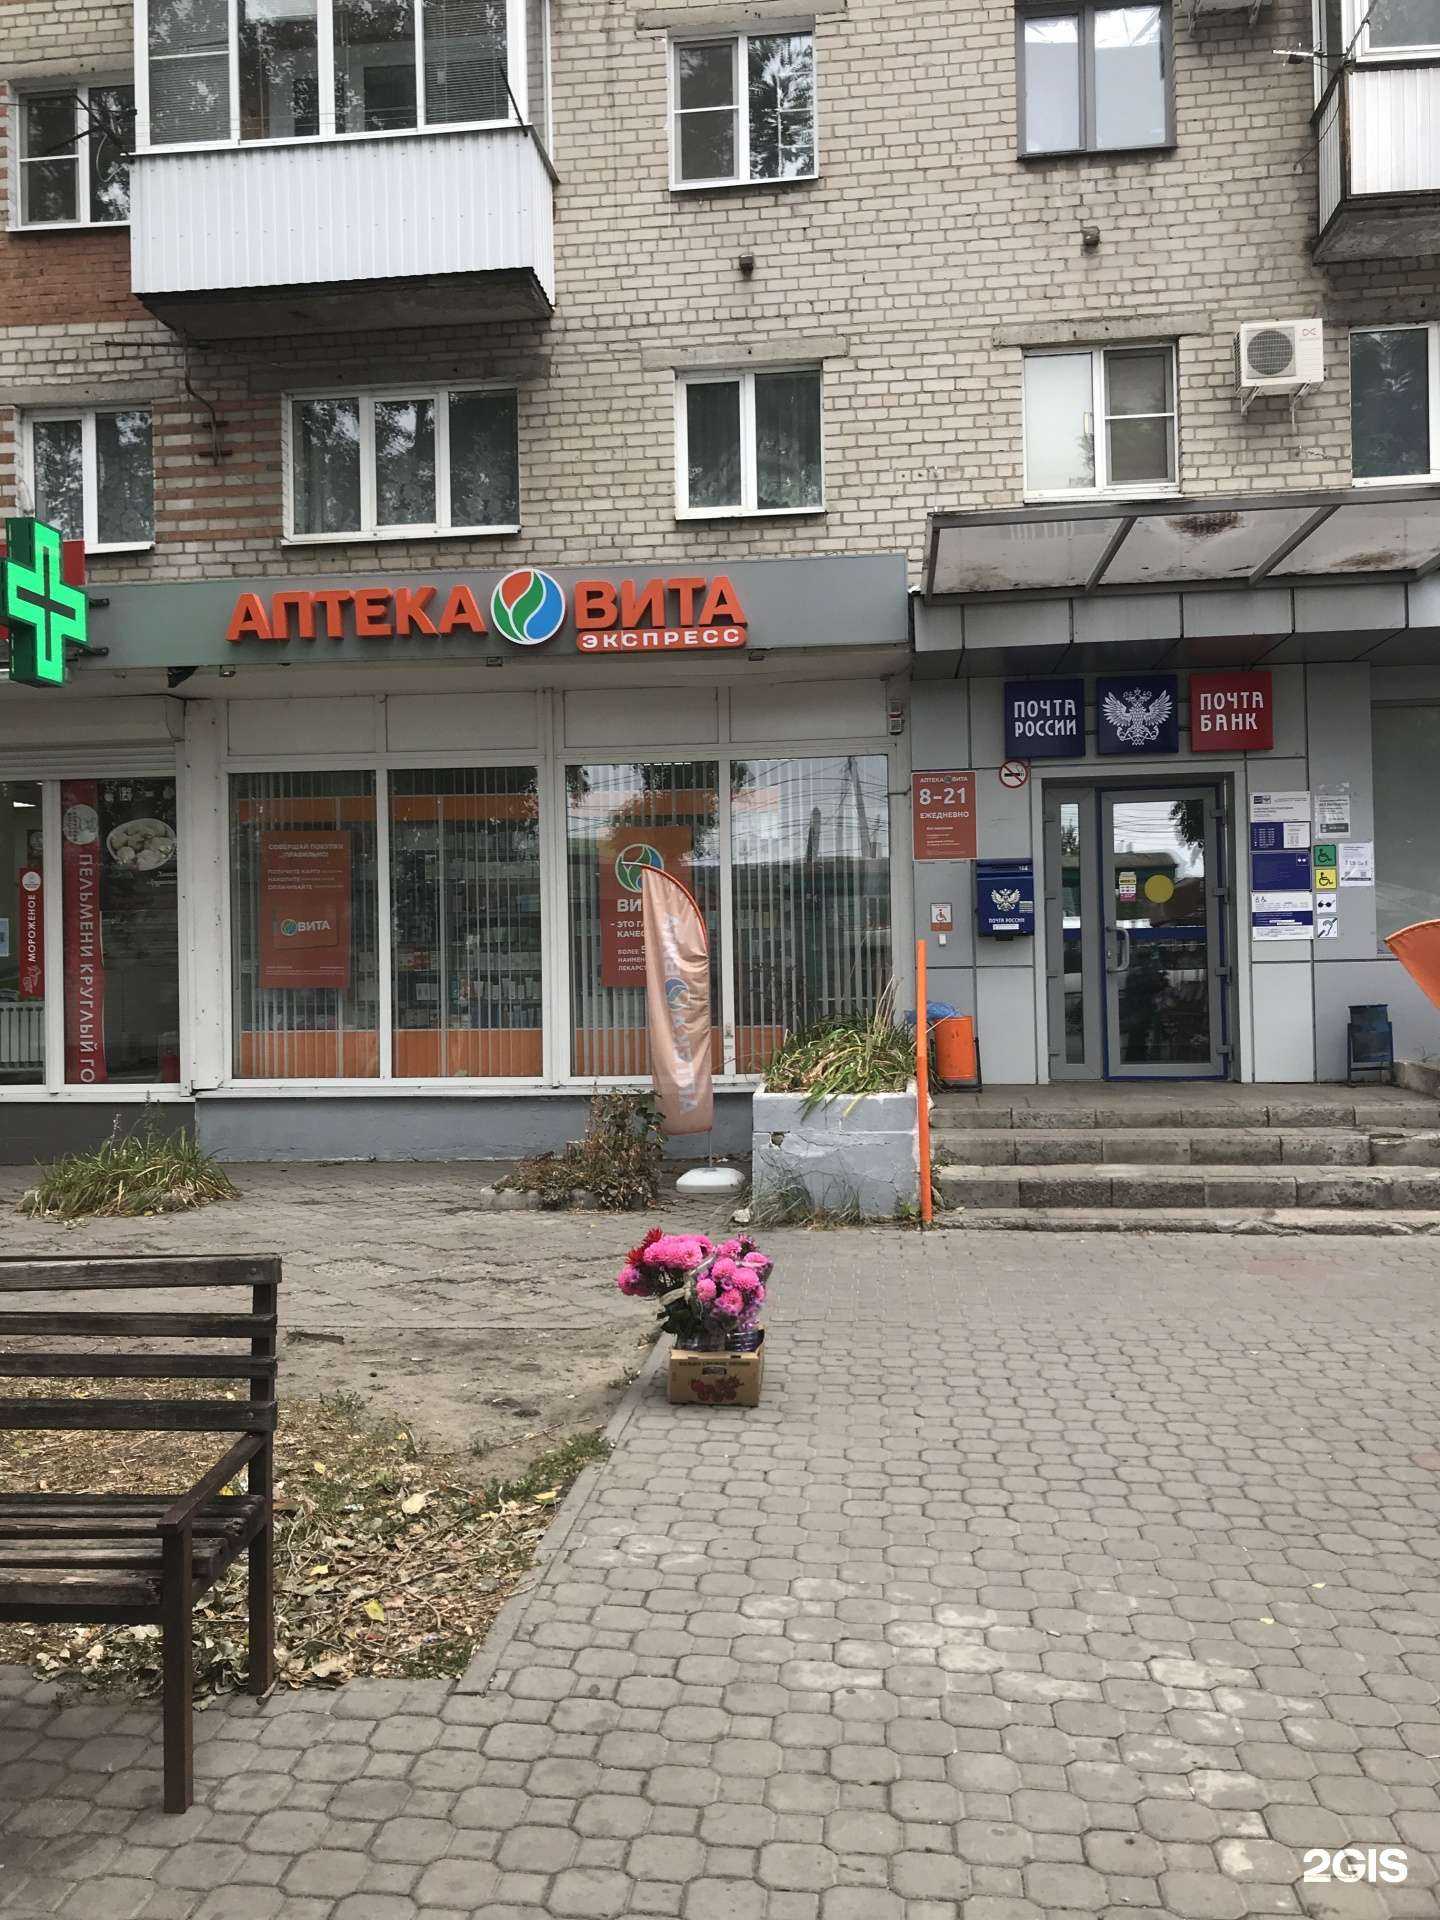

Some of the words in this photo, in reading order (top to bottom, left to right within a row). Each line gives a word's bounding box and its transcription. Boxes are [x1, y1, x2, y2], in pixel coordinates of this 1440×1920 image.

[226, 584, 488, 641] АПТЕКА
[574, 576, 748, 631] ВИТА
[582, 628, 740, 650] ЭКСПРЕСС
[1014, 699, 1077, 718] ПОЧТА
[1200, 691, 1264, 710] ПОЧТА
[1014, 719, 1077, 737] РОССИИ
[1200, 712, 1258, 732] БАНК
[920, 811, 969, 820] ЕЖЕДНЕВНО
[79, 854, 93, 958] ПЕЛЬМЕНИ
[616, 898, 642, 913] ВИ
[27, 895, 36, 962] МОРОЖЕНОЕ
[297, 920, 331, 932] ВИТА
[617, 920, 635, 929] ЭТО
[79, 963, 97, 1053] КРУГЛЫЙ
[80, 1059, 95, 1083] ГО
